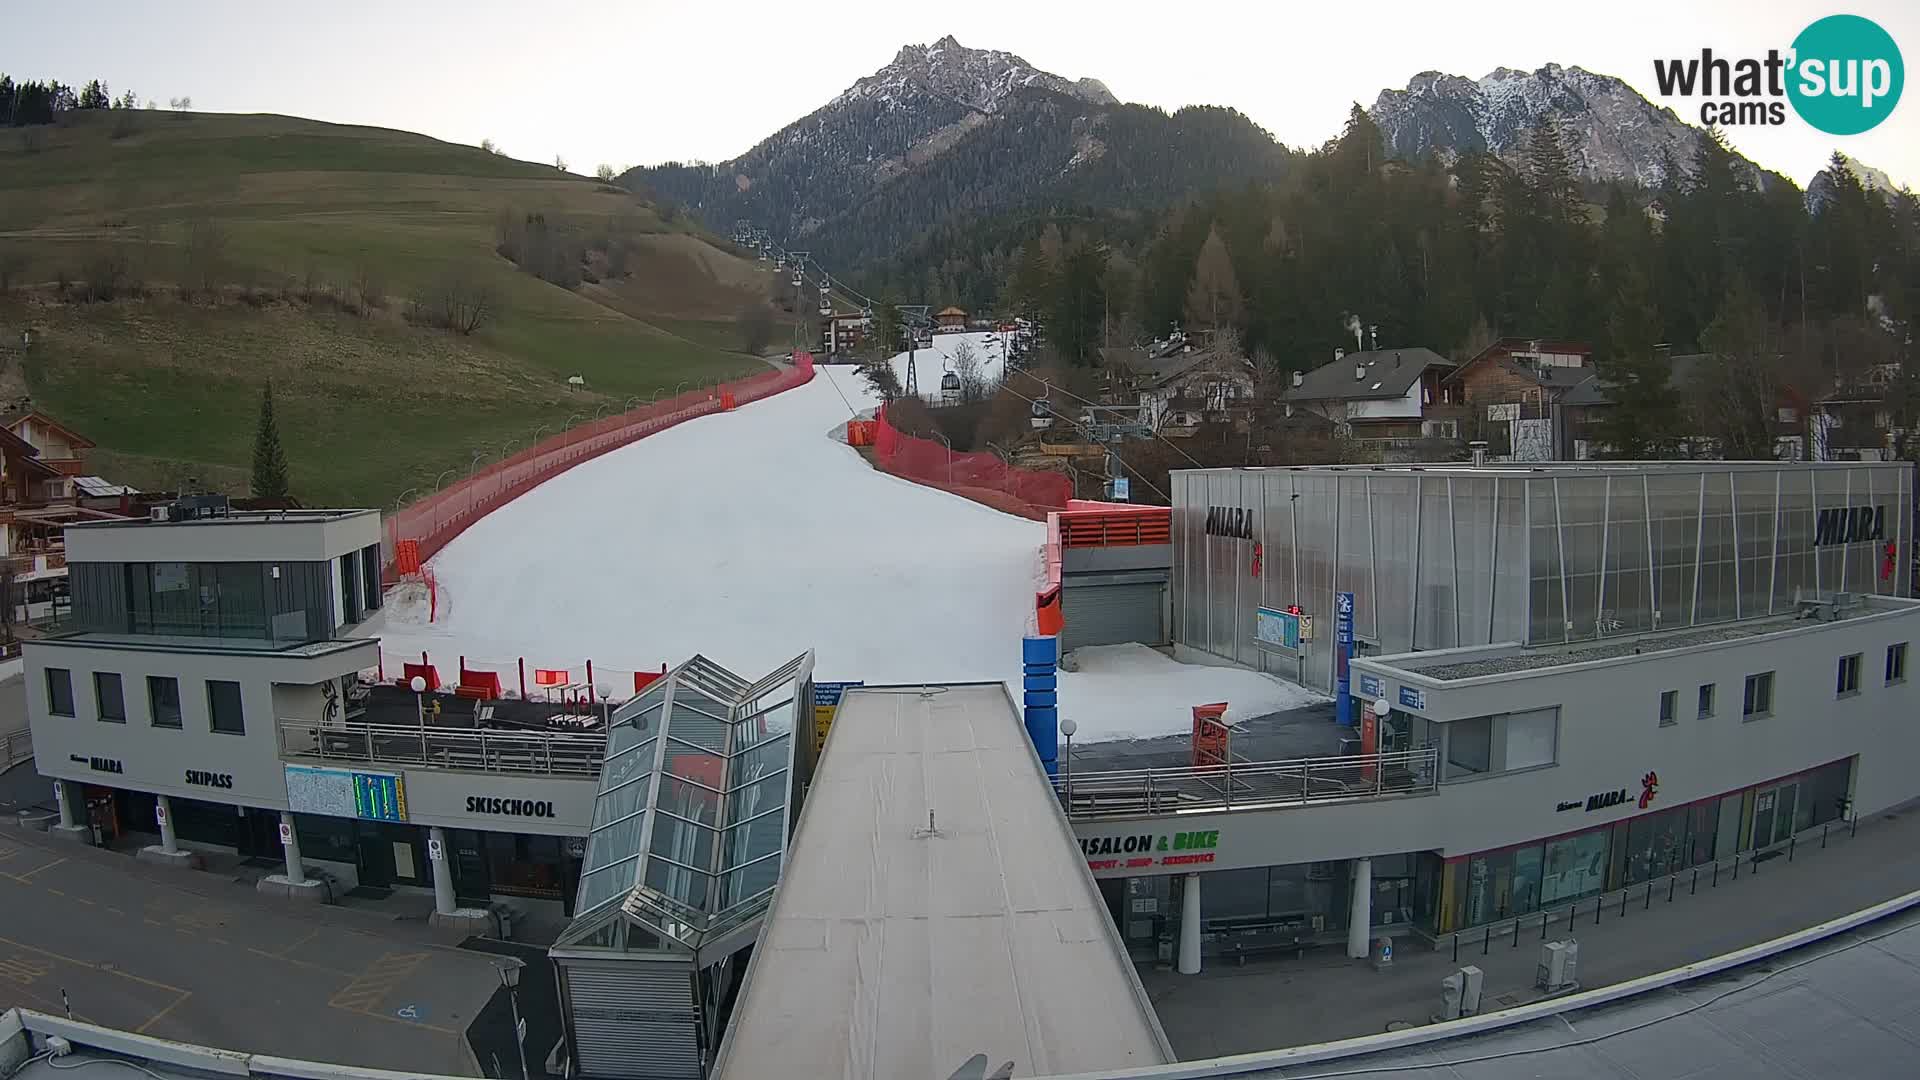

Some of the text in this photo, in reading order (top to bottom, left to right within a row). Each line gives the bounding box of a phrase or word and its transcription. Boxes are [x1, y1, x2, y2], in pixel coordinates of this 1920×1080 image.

[1206, 506, 1253, 539] MIARA
[1814, 505, 1884, 546] MIARA
[90, 757, 123, 774] MIARA
[185, 769, 233, 789] SKIPASS
[466, 796, 555, 818] SKISCHOOL
[1585, 789, 1626, 812] MIARA
[1173, 830, 1219, 850] BIKE
